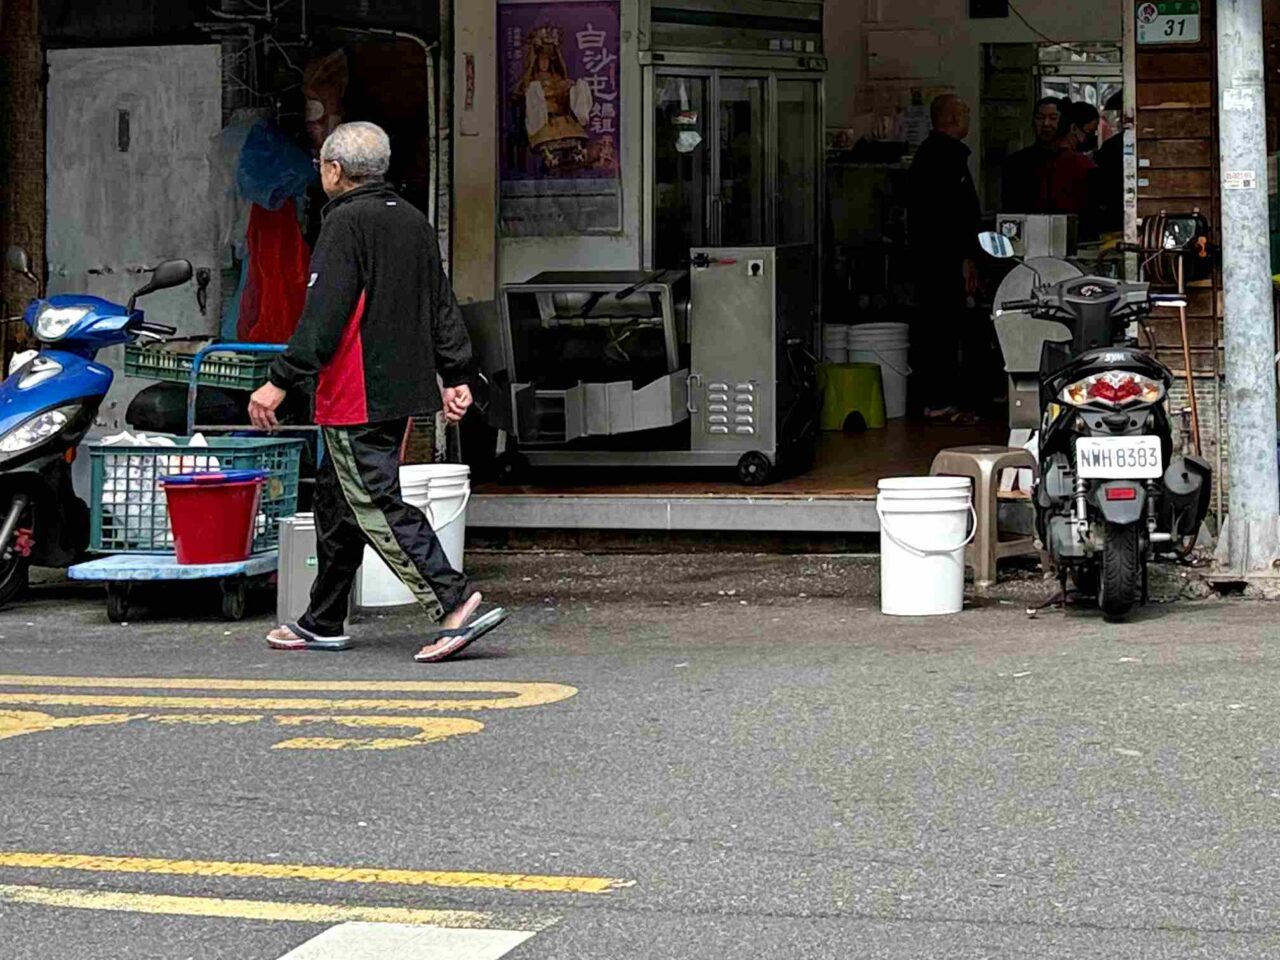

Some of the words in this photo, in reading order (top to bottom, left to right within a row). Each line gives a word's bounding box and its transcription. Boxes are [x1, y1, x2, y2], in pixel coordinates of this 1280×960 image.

[1163, 19, 1186, 37] 31
[575, 23, 618, 133] 白沙屯媽祖
